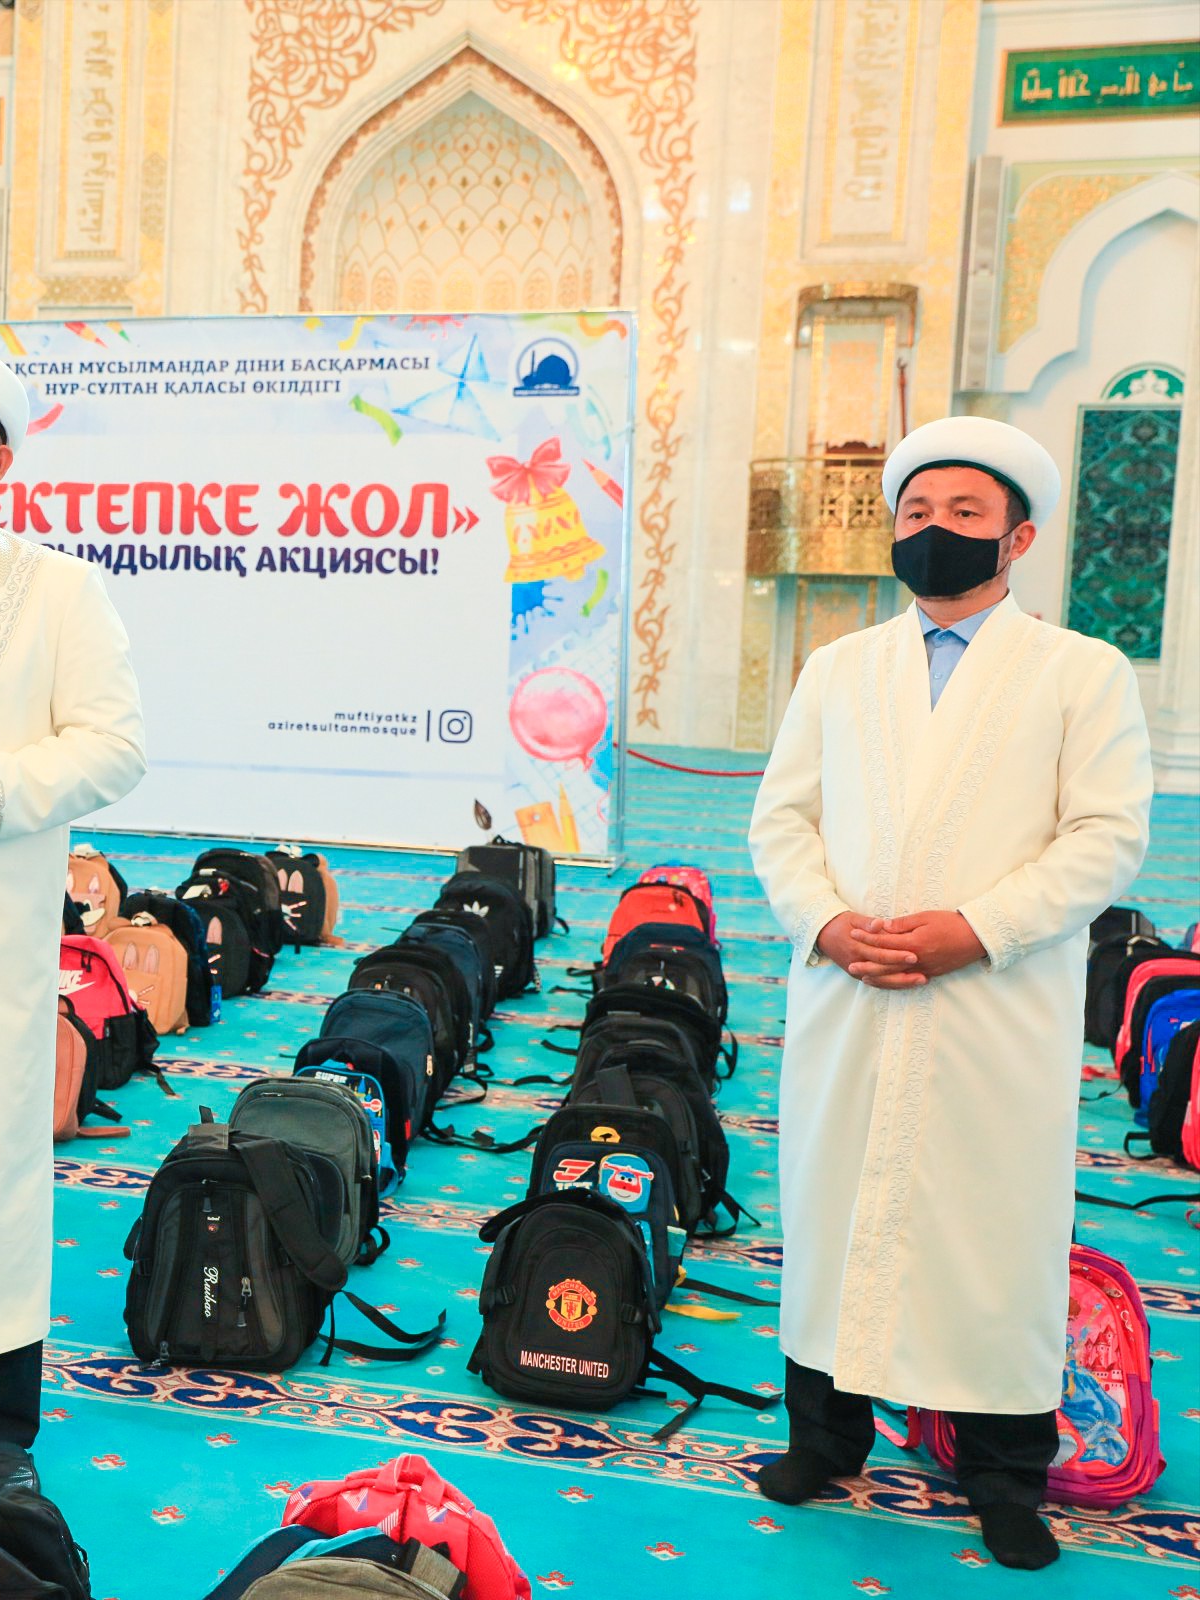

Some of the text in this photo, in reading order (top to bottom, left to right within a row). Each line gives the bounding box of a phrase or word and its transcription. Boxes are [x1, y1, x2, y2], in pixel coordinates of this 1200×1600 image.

[6, 361, 73, 378] ҚСТАН
[235, 359, 284, 374] ДІНИ
[291, 356, 430, 374] БАСҚАРМАСЫ
[164, 380, 246, 397] ҚАЛАСЫ
[253, 379, 341, 395] ӨКІЛДІГІ
[277, 482, 481, 538] ЖОЛ»
[42, 543, 439, 579] МДЫЛЫҚ АКЦИЯСЫ!
[334, 711, 418, 724] muftiyatkz
[267, 720, 417, 737] aziretsultanmosque
[314, 1071, 348, 1084] SUPER
[204, 1266, 219, 1317] Ruibao
[552, 1282, 592, 1303] MANCHESTER
[557, 1317, 585, 1328] UNITED
[520, 1350, 609, 1378] MANCHESTER UNITED
